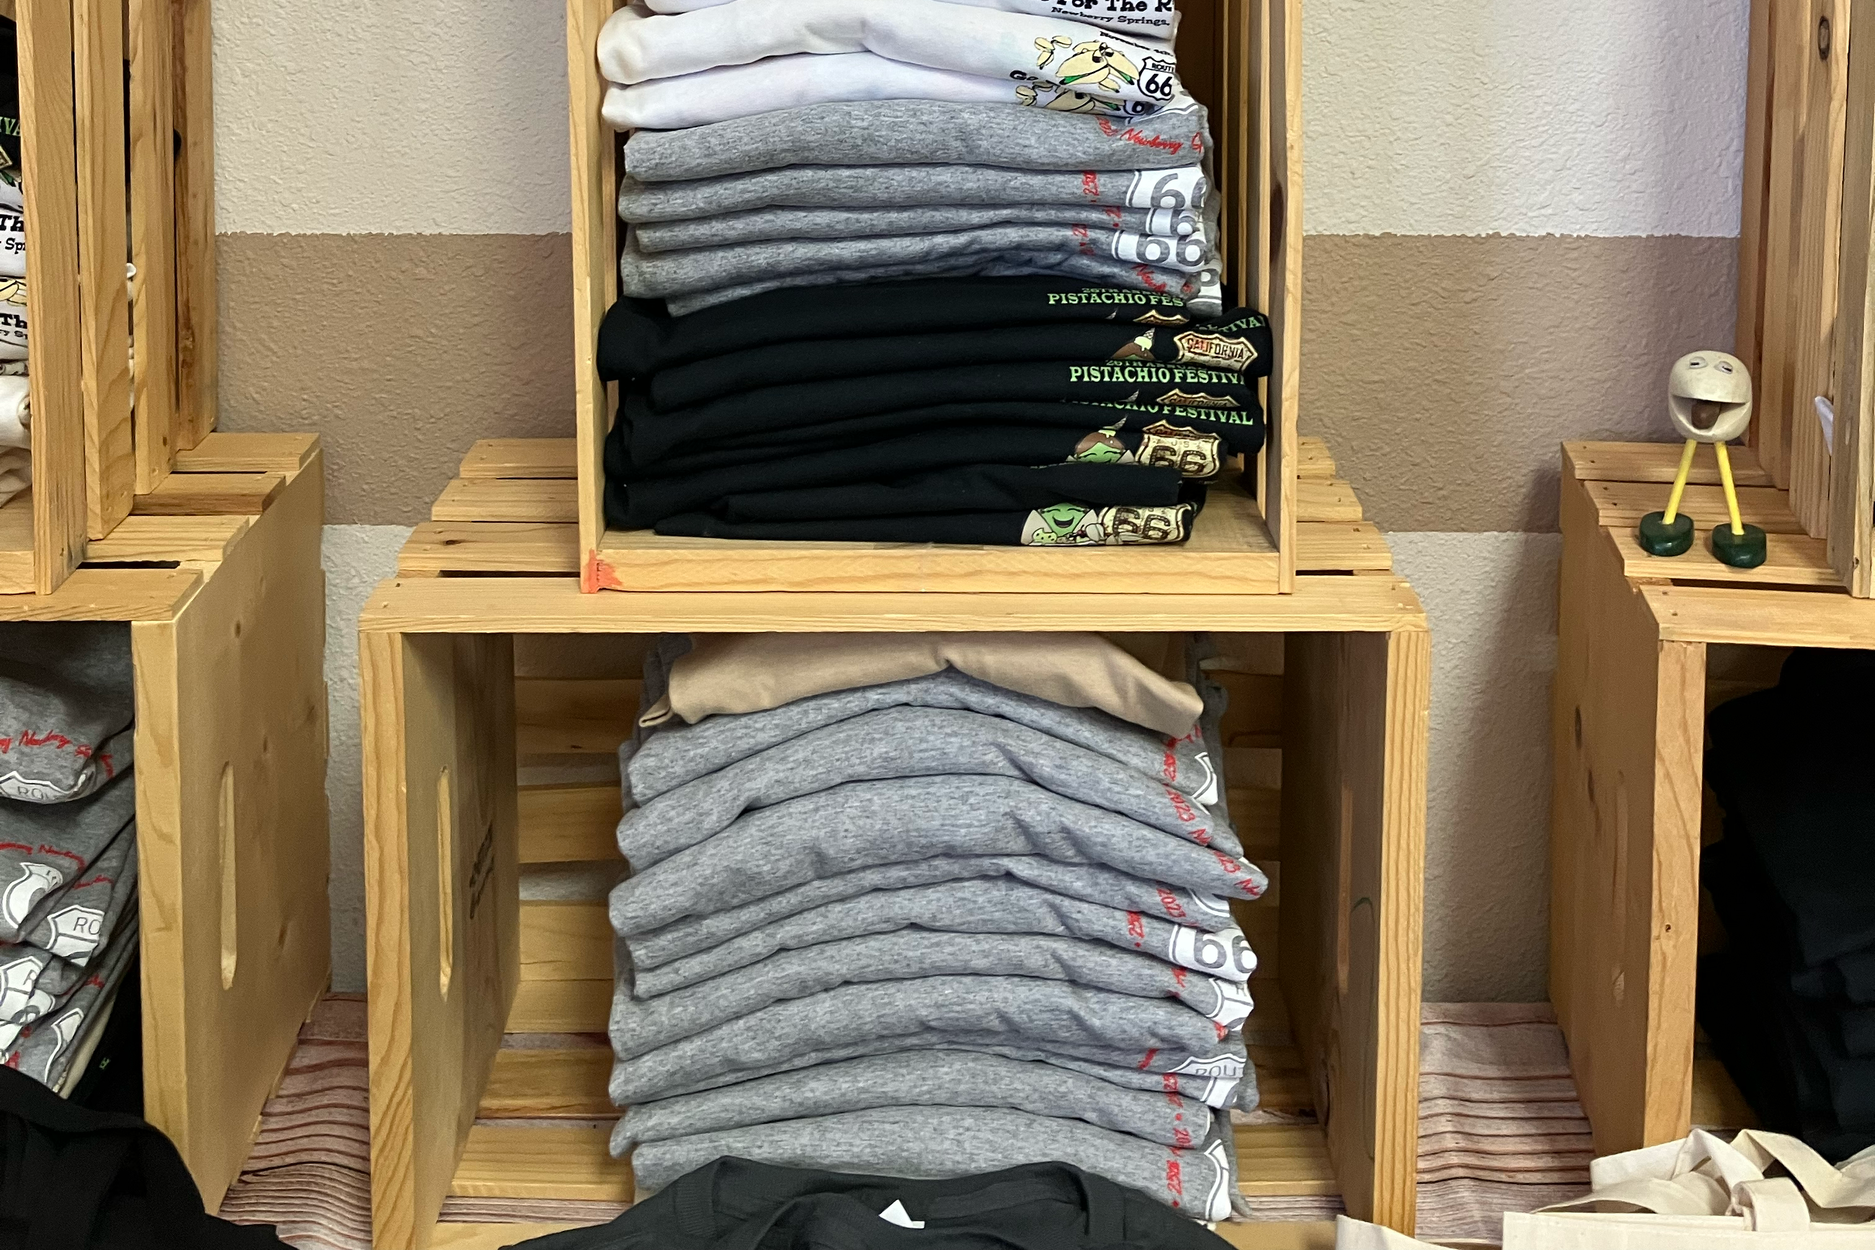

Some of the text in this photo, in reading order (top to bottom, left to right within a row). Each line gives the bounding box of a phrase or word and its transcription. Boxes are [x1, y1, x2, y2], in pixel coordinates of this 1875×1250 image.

[1051, 6, 1114, 23] Newberry
[1145, 73, 1173, 97] 66
[1047, 293, 1146, 305] PISTACHIO
[1186, 337, 1246, 361] CALIFORNIA
[1069, 366, 1170, 383] PISTACHIO
[1112, 506, 1171, 540] 66
